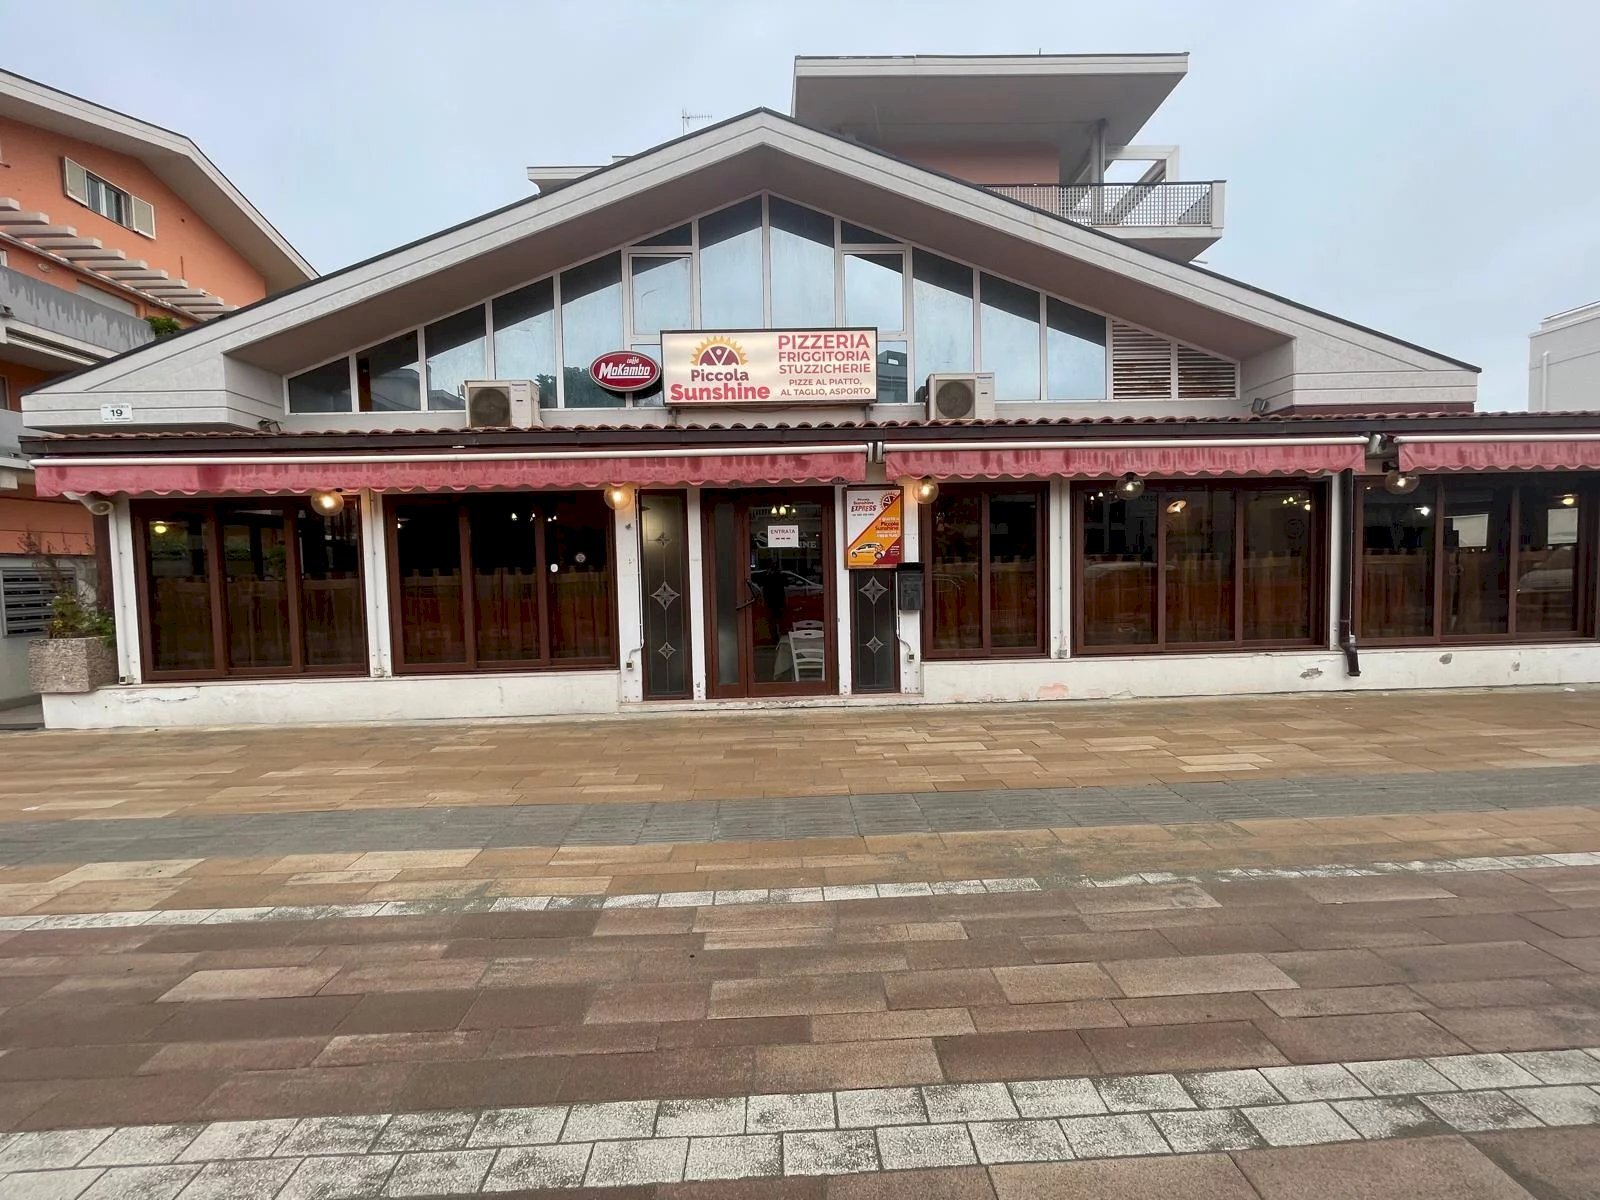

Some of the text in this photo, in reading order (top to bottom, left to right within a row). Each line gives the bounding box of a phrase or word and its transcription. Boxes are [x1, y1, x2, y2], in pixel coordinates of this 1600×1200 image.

[778, 334, 870, 349] PIZZERIA
[778, 351, 870, 362] FRIGGITORIA
[779, 363, 871, 374] STUZZICHERIE
[690, 368, 749, 382] Piccola
[789, 377, 862, 386] PIZZE AL PIATTO,
[670, 382, 771, 401] Sunshine
[793, 388, 827, 396] TAGLIO,
[829, 387, 871, 395] ASPORTO
[110, 408, 123, 417] 19
